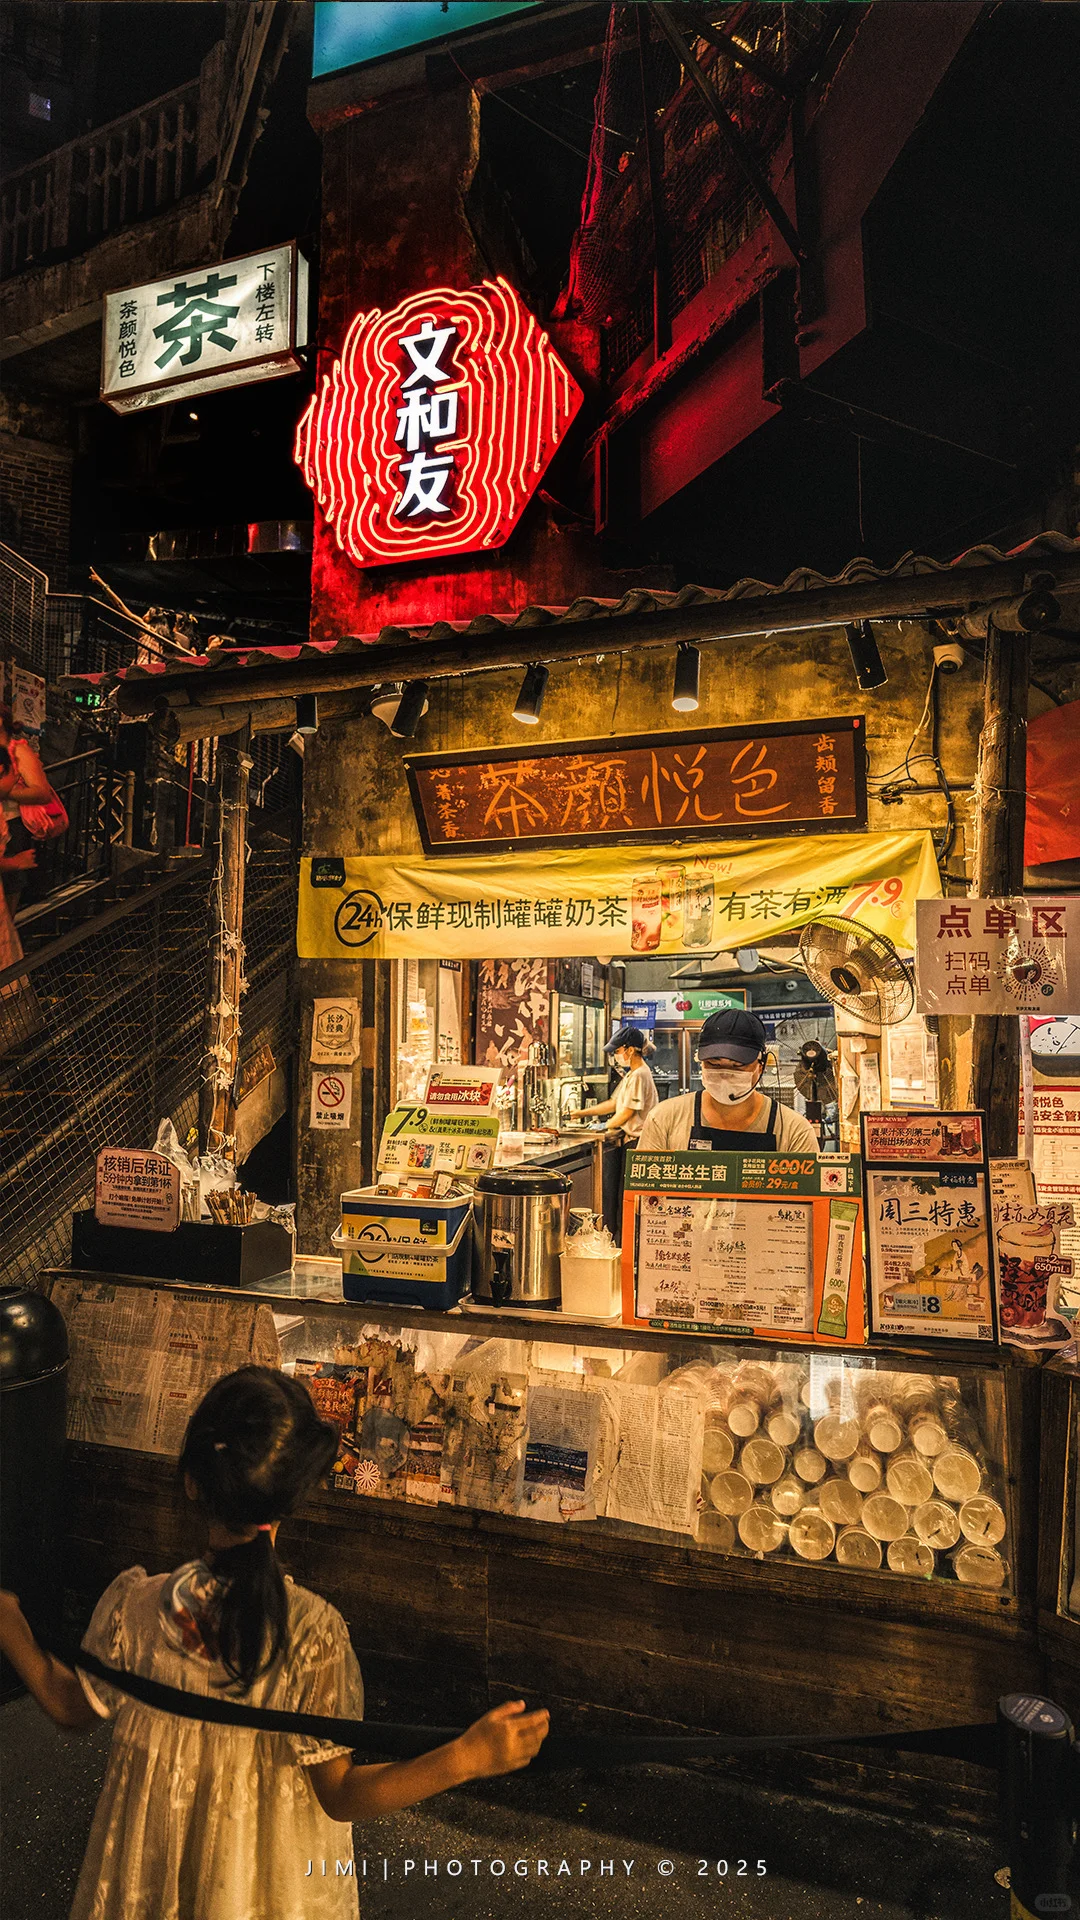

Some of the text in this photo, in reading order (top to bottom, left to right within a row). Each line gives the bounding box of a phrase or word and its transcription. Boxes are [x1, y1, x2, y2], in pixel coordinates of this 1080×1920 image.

[255, 261, 276, 343] 下楼左转
[152, 272, 241, 370] 茶
[118, 299, 138, 379] 茶颜悦色
[394, 320, 458, 518] 文和友
[480, 740, 791, 838] 茶颜悦色
[693, 853, 733, 875] New!
[386, 894, 629, 932] 保鲜现制罐罐奶茶
[718, 884, 850, 923] 有茶有酒
[936, 904, 1068, 939] 点单区
[944, 951, 991, 972] 扫码
[945, 974, 991, 996] 点单
[102, 1172, 173, 1189] 5分钟内拿到第1杯
[103, 1155, 172, 1176] 核销后保证
[629, 1163, 728, 1182] 即食型益生菌
[879, 1197, 981, 1229] 周三特惠
[1034, 1262, 1066, 1273] 650mL
[926, 1296, 941, 1314] 8
